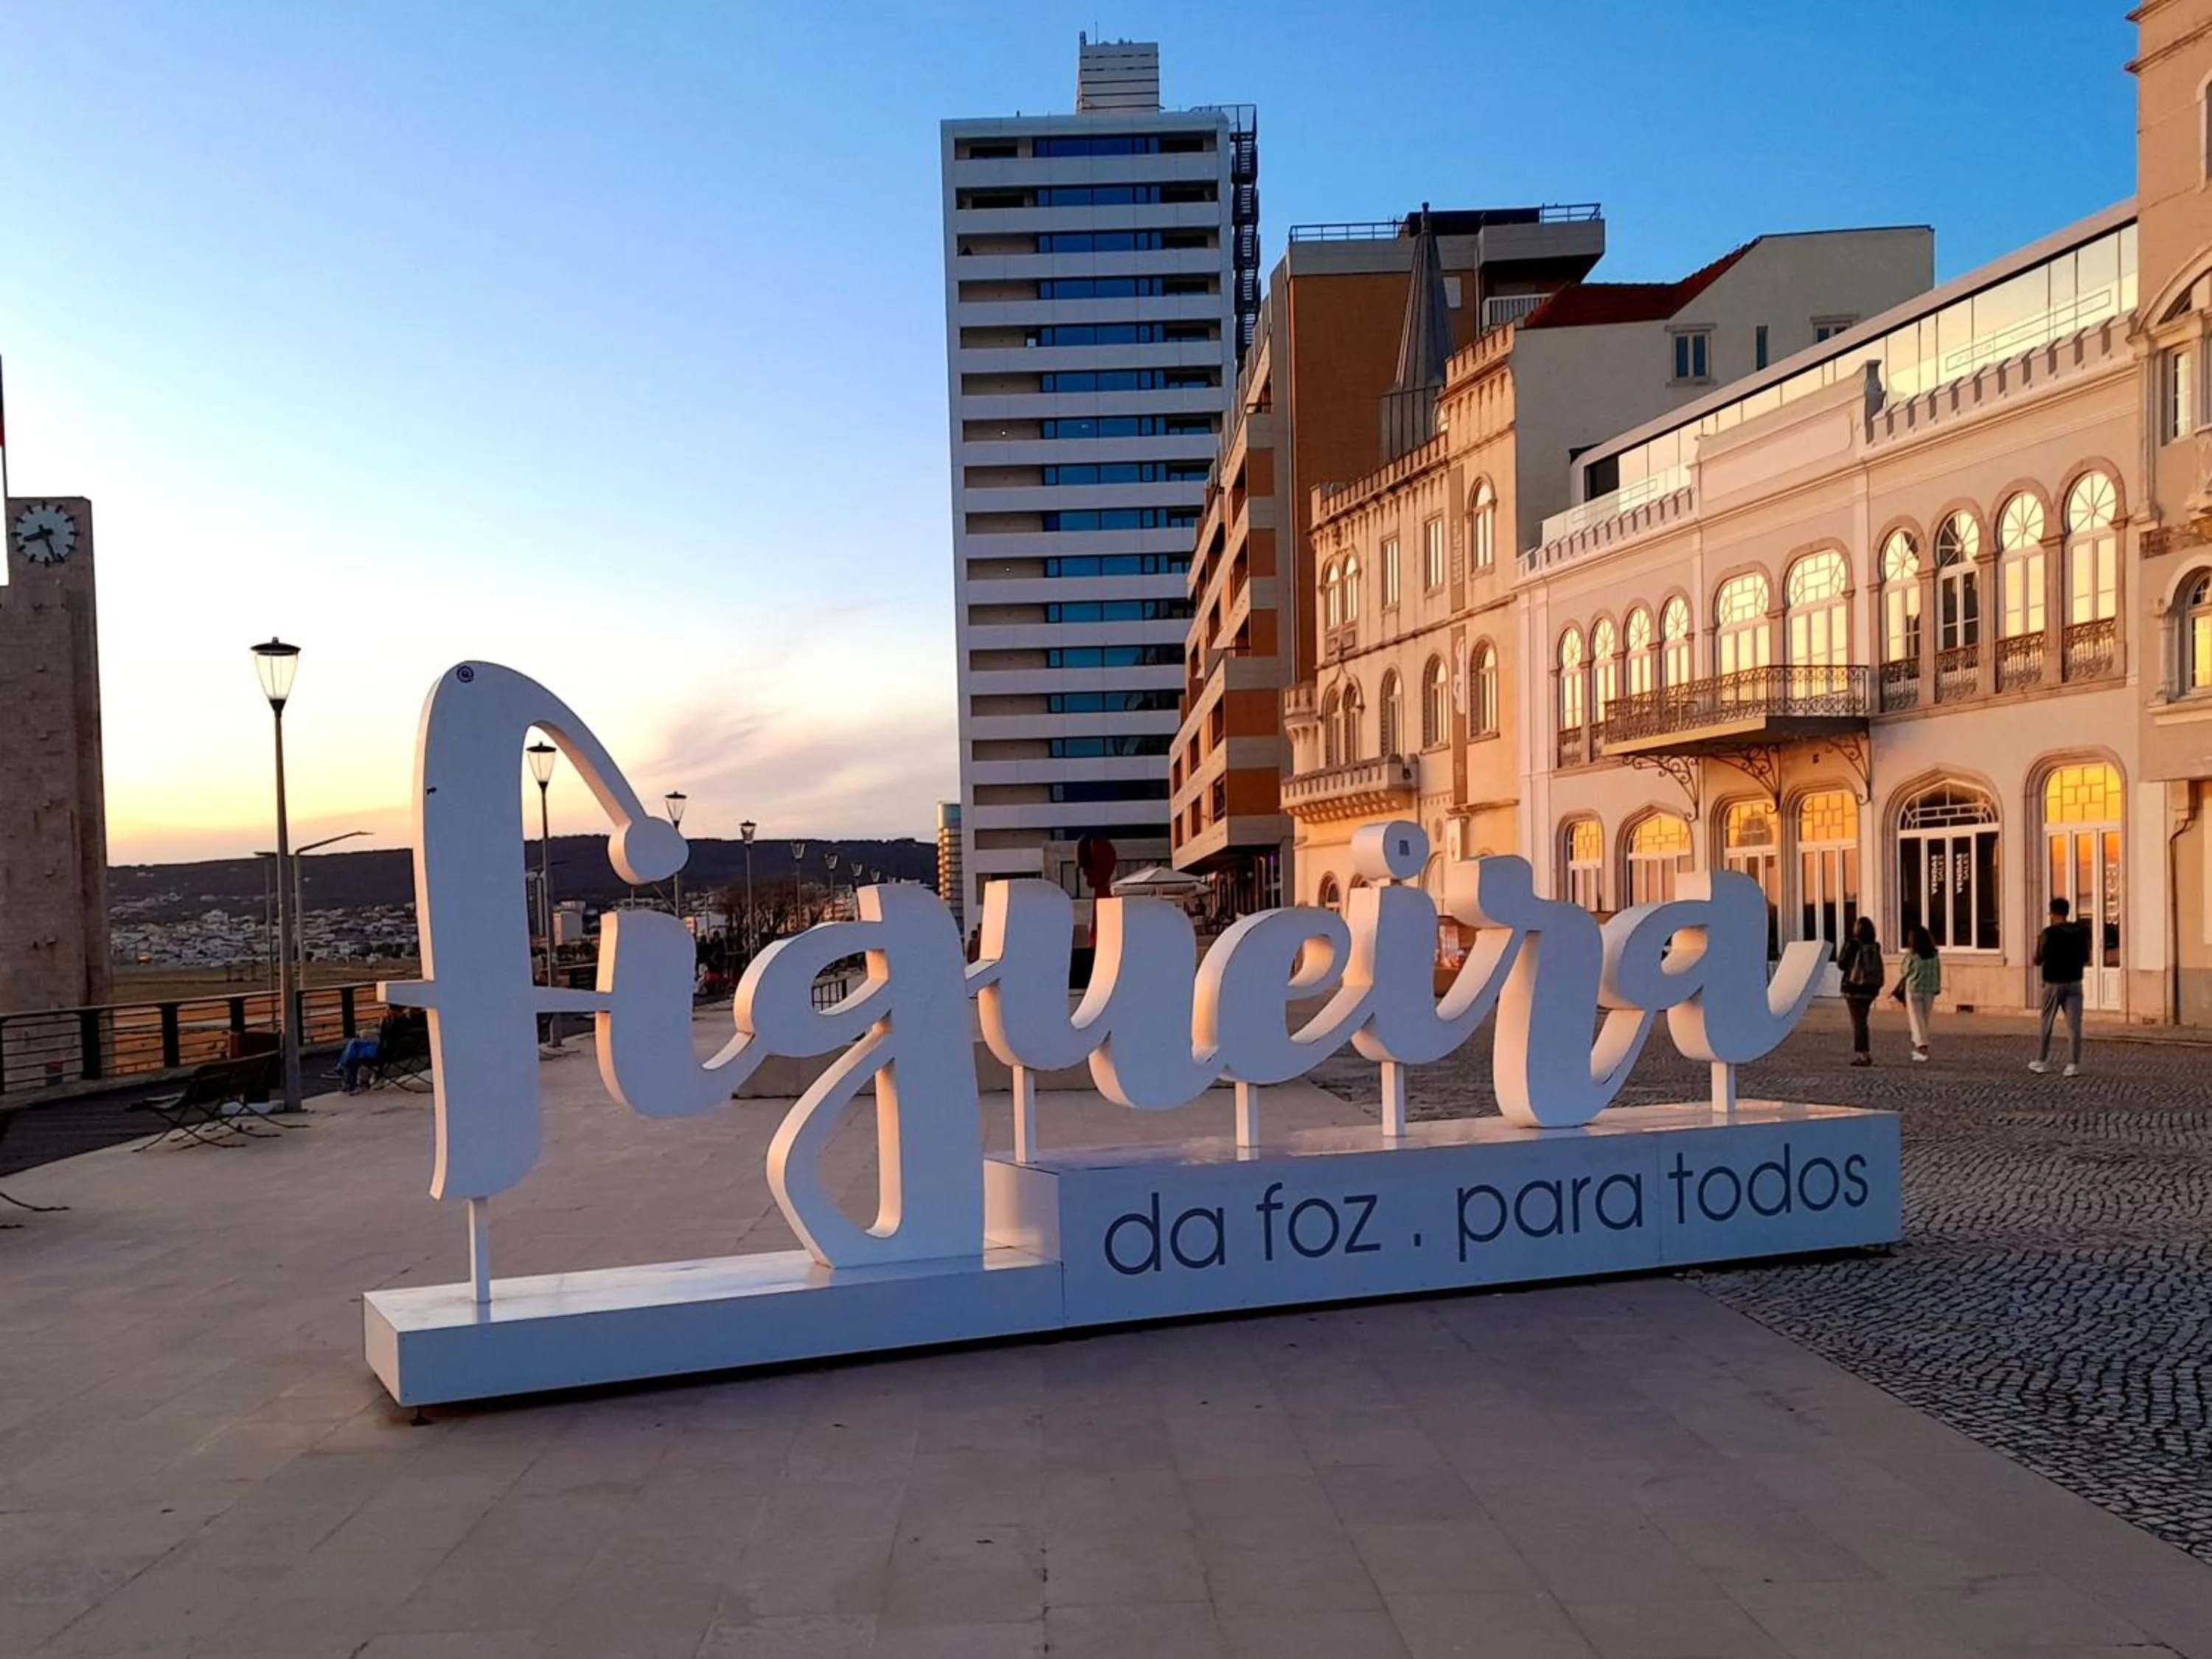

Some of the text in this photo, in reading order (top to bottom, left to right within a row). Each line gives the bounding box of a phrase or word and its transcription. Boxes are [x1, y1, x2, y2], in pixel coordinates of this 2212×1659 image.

[377, 661, 1833, 1268] figueira
[1105, 1192, 1225, 1275] da
[1256, 1182, 1381, 1261] foz
[1457, 1173, 1643, 1262] para
[1668, 1143, 1868, 1224] todos
